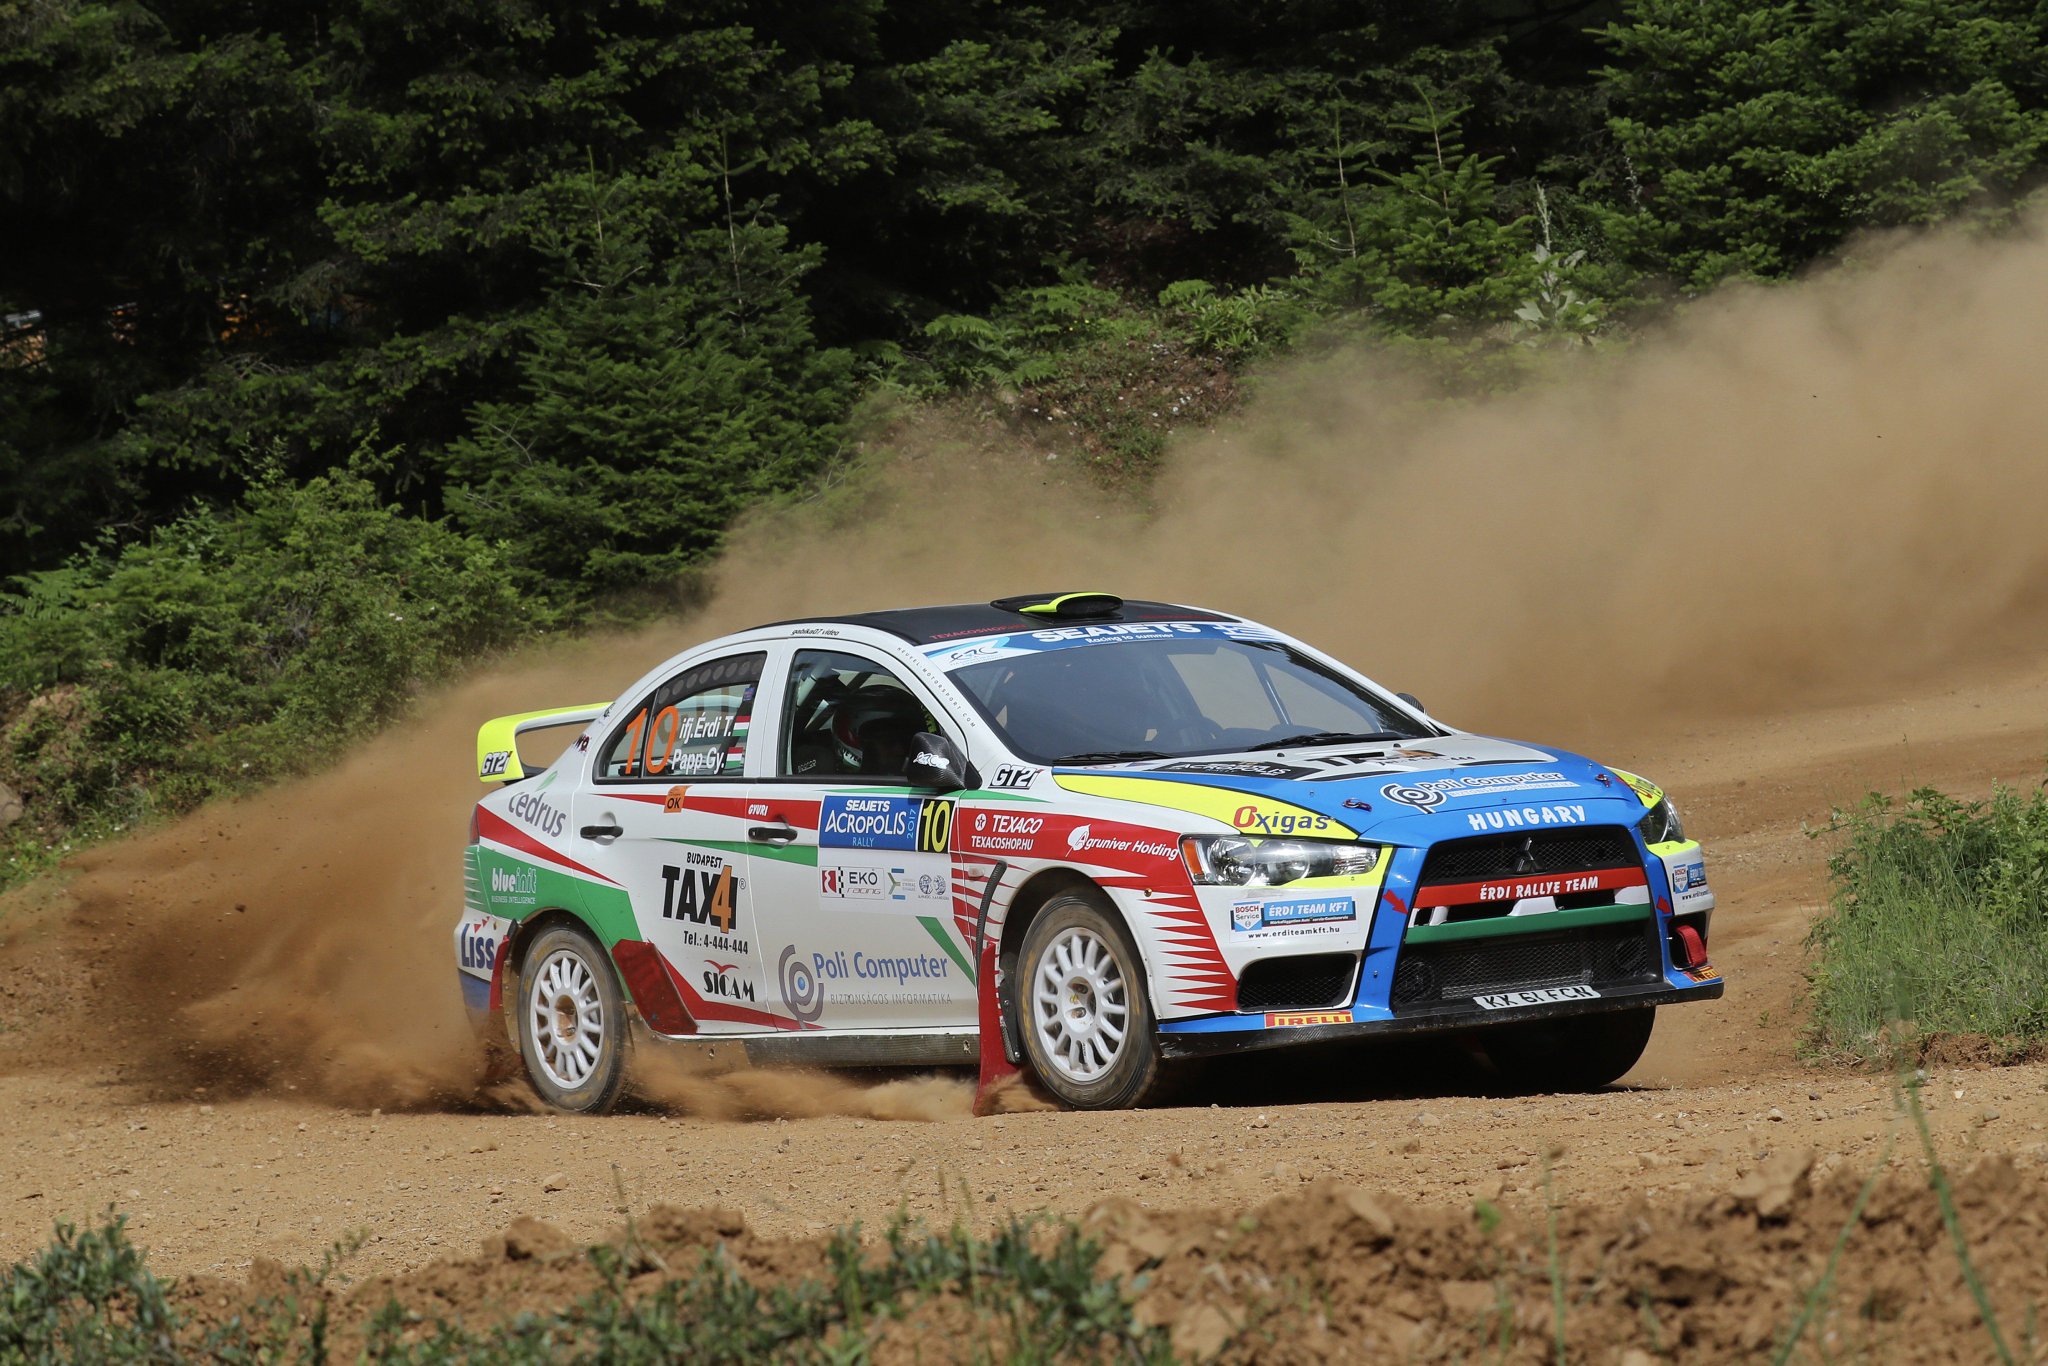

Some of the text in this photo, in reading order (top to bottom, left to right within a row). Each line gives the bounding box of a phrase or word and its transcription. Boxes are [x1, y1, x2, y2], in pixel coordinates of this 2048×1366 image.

[1032, 623, 1201, 642] SEAJETS
[1085, 636, 1122, 644] Racing
[723, 715, 734, 737] T.
[625, 705, 679, 775] 10
[481, 751, 512, 775] GT2i
[671, 747, 725, 775] Papp Gy.
[990, 763, 1043, 789] GT2i
[1421, 778, 1458, 793] Poli
[1463, 772, 1563, 786] Computer
[667, 797, 681, 809] OK
[748, 804, 768, 816] GYURI
[845, 799, 890, 812] SEAJETS
[508, 791, 566, 837] cedrus
[824, 810, 907, 835] ACROPOLIS
[907, 808, 916, 839] 2017
[993, 814, 1043, 834] TEXACO
[1233, 805, 1329, 834] Oxigas
[1467, 805, 1586, 830] HUNGARY
[922, 800, 950, 852] 10
[852, 837, 875, 847] RALLY
[971, 835, 1034, 850] TEXACOSHOP.HU
[1132, 840, 1179, 860] Holding
[687, 852, 722, 868] BUDAPEST
[848, 871, 878, 885] EKO
[1480, 876, 1599, 900] ÉRDI RALLYE TEAM
[1235, 906, 1259, 914] BOSCH
[1269, 901, 1349, 917] ÉRDI TEAM KFT
[1248, 926, 1340, 939] www.erditeamkft.hu
[684, 931, 748, 955] Tel.: 4-444-444
[813, 951, 948, 985] Poli Computer
[703, 971, 755, 1003] SICAM
[1545, 986, 1593, 1000] FCN
[830, 992, 952, 1005] BIZTONSÁGOS INFORMATIKA
[1265, 1010, 1352, 1028] PIRELLI
